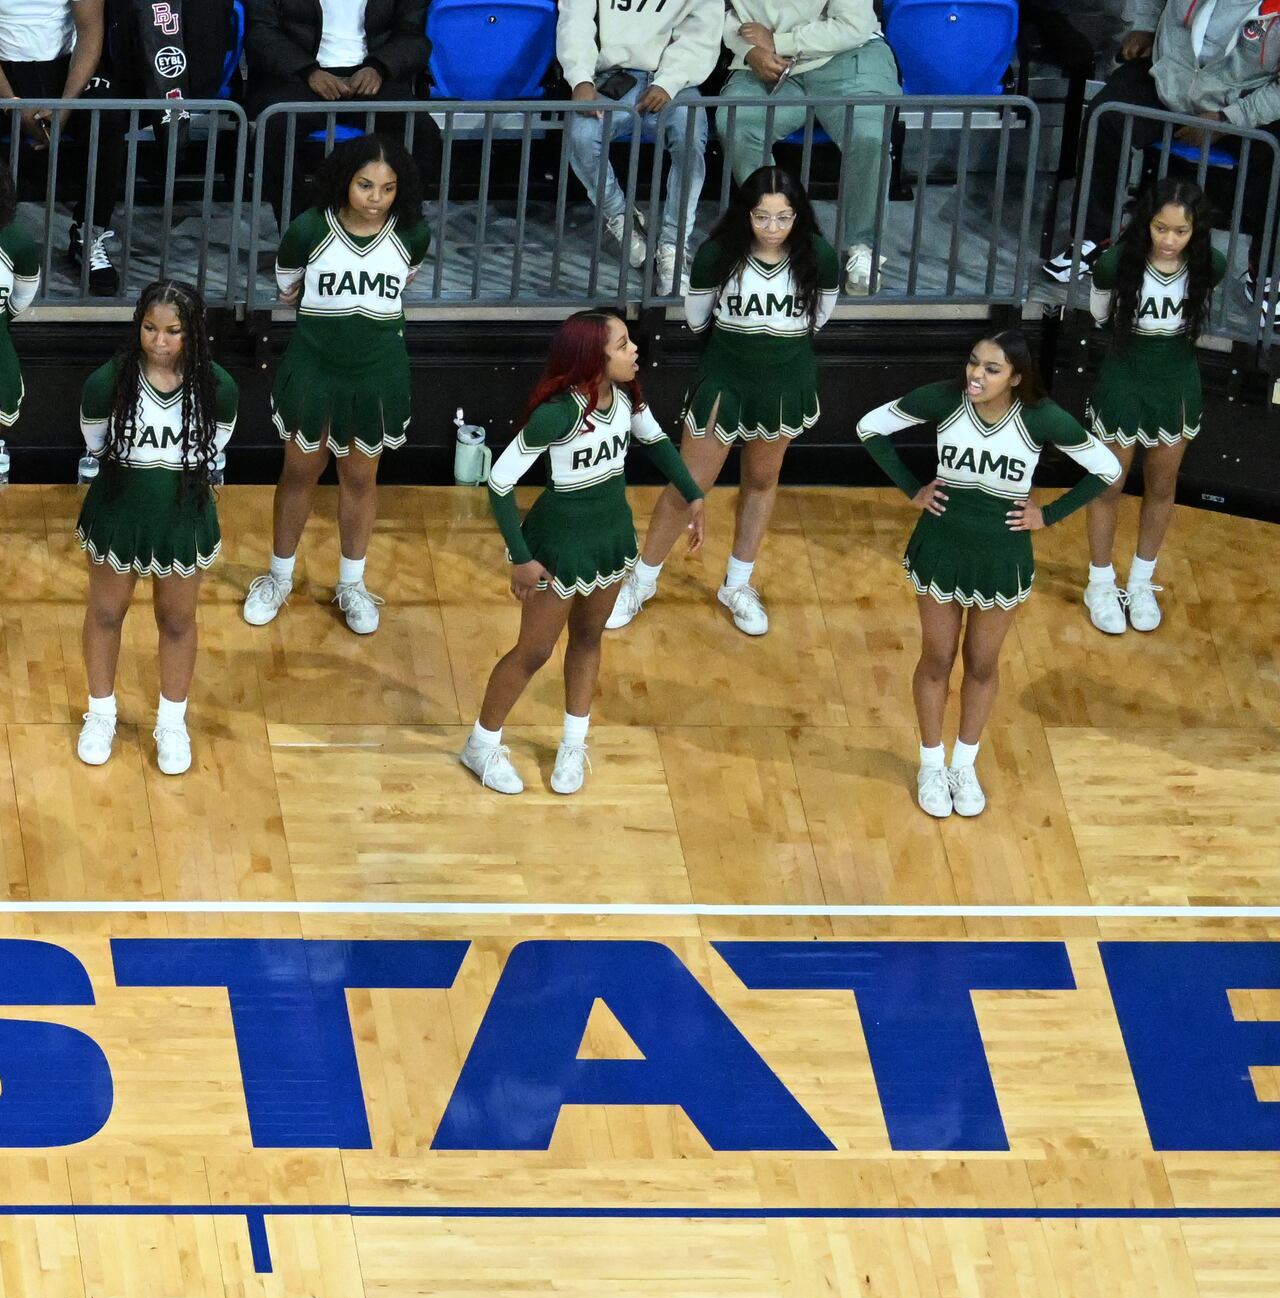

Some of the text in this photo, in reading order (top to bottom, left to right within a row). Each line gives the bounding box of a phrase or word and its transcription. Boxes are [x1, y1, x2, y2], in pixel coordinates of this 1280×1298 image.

[152, 2, 179, 35] BU
[159, 56, 183, 66] EYBL
[319, 271, 400, 299] RAMS
[727, 293, 807, 317] RAMS
[1137, 297, 1186, 319] AM
[572, 430, 629, 470] RAM
[941, 445, 1026, 481] RAMS
